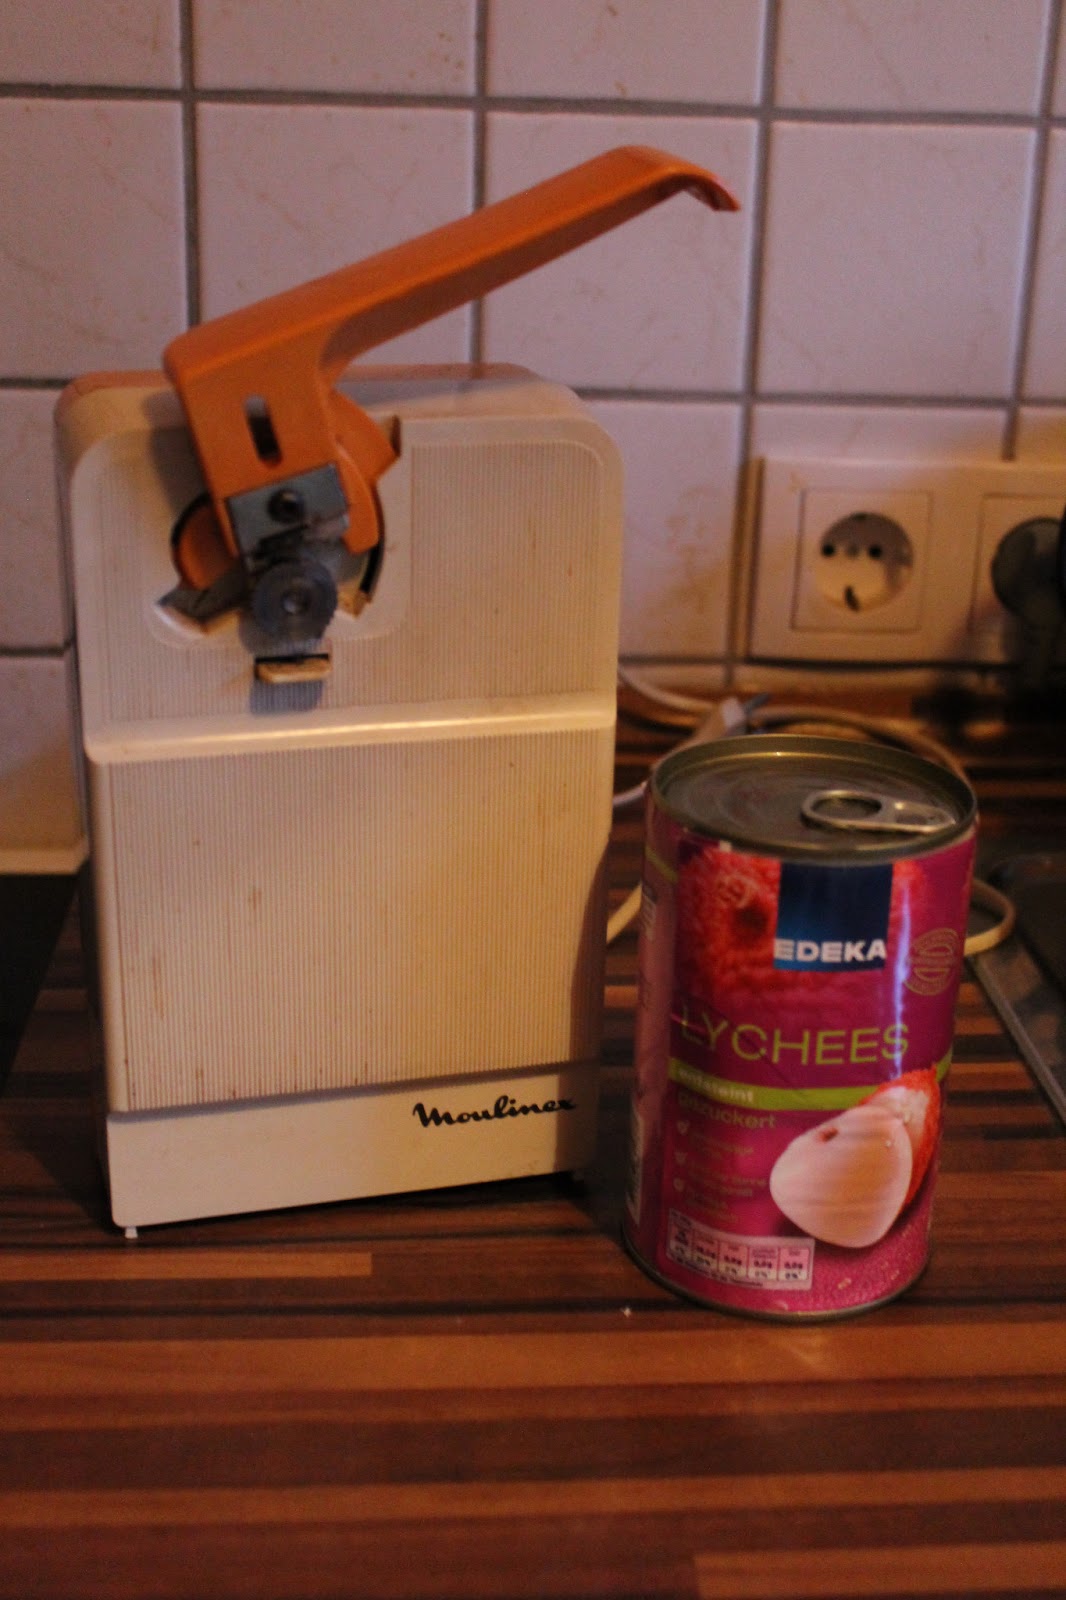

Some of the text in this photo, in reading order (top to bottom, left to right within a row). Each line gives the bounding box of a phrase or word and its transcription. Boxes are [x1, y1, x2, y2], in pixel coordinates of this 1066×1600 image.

[773, 938, 887, 963] EDEKA
[681, 1004, 909, 1065] LYCHEES
[412, 1095, 577, 1128] Moulinex
